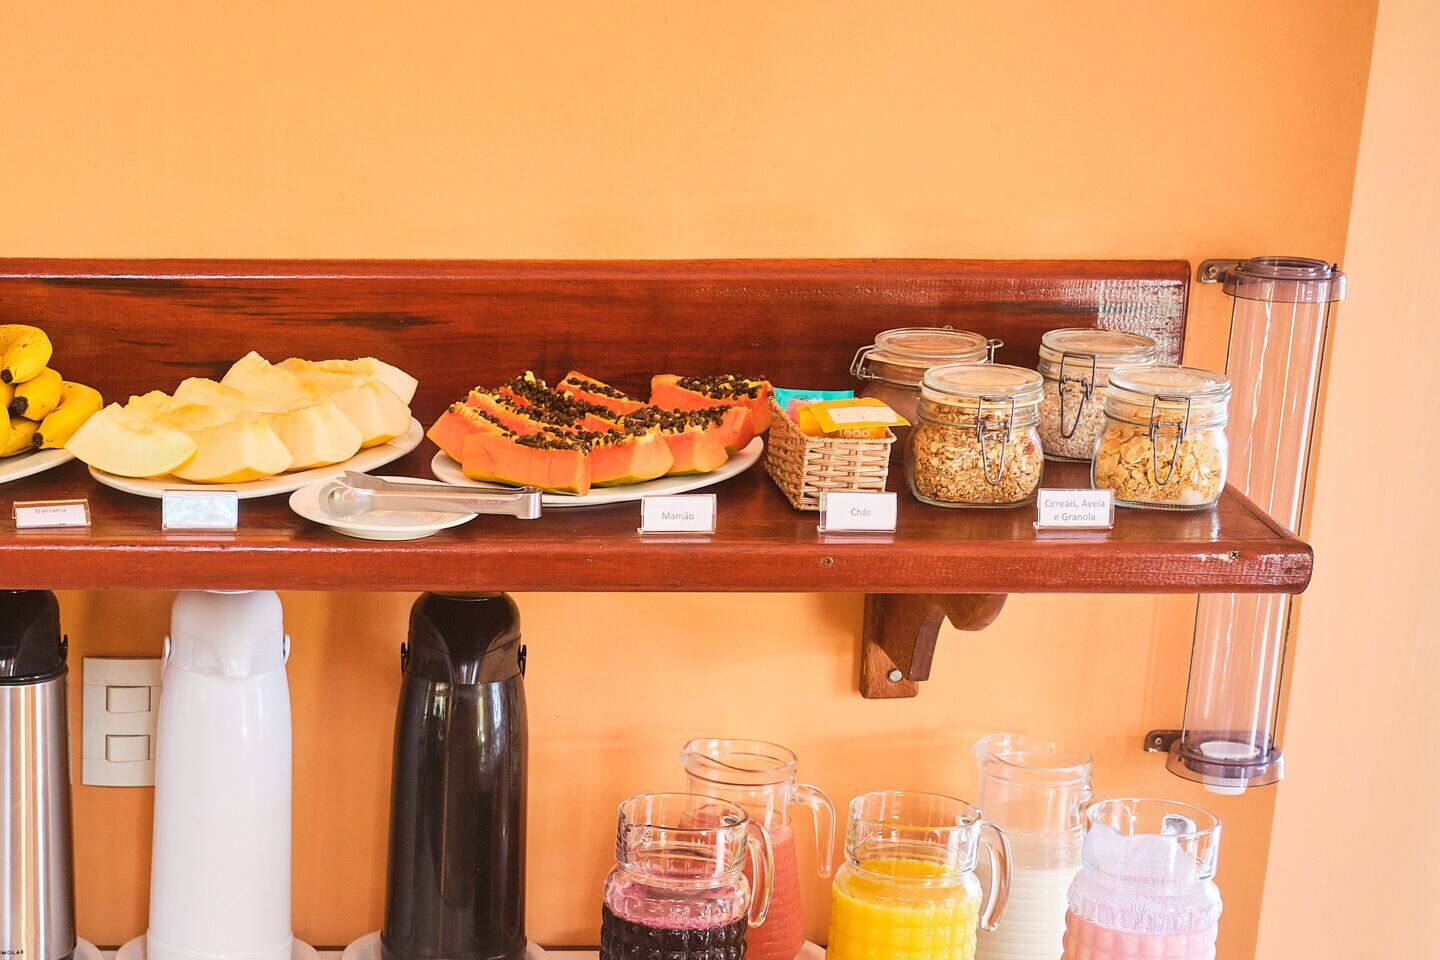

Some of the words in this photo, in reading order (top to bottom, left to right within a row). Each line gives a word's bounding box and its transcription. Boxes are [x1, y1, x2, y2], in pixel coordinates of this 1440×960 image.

[1044, 499, 1079, 508] Cereais,
[1081, 499, 1105, 508] Aveia
[661, 511, 695, 520] Mamão
[850, 507, 872, 517] Chás
[1061, 512, 1096, 521] Granola
